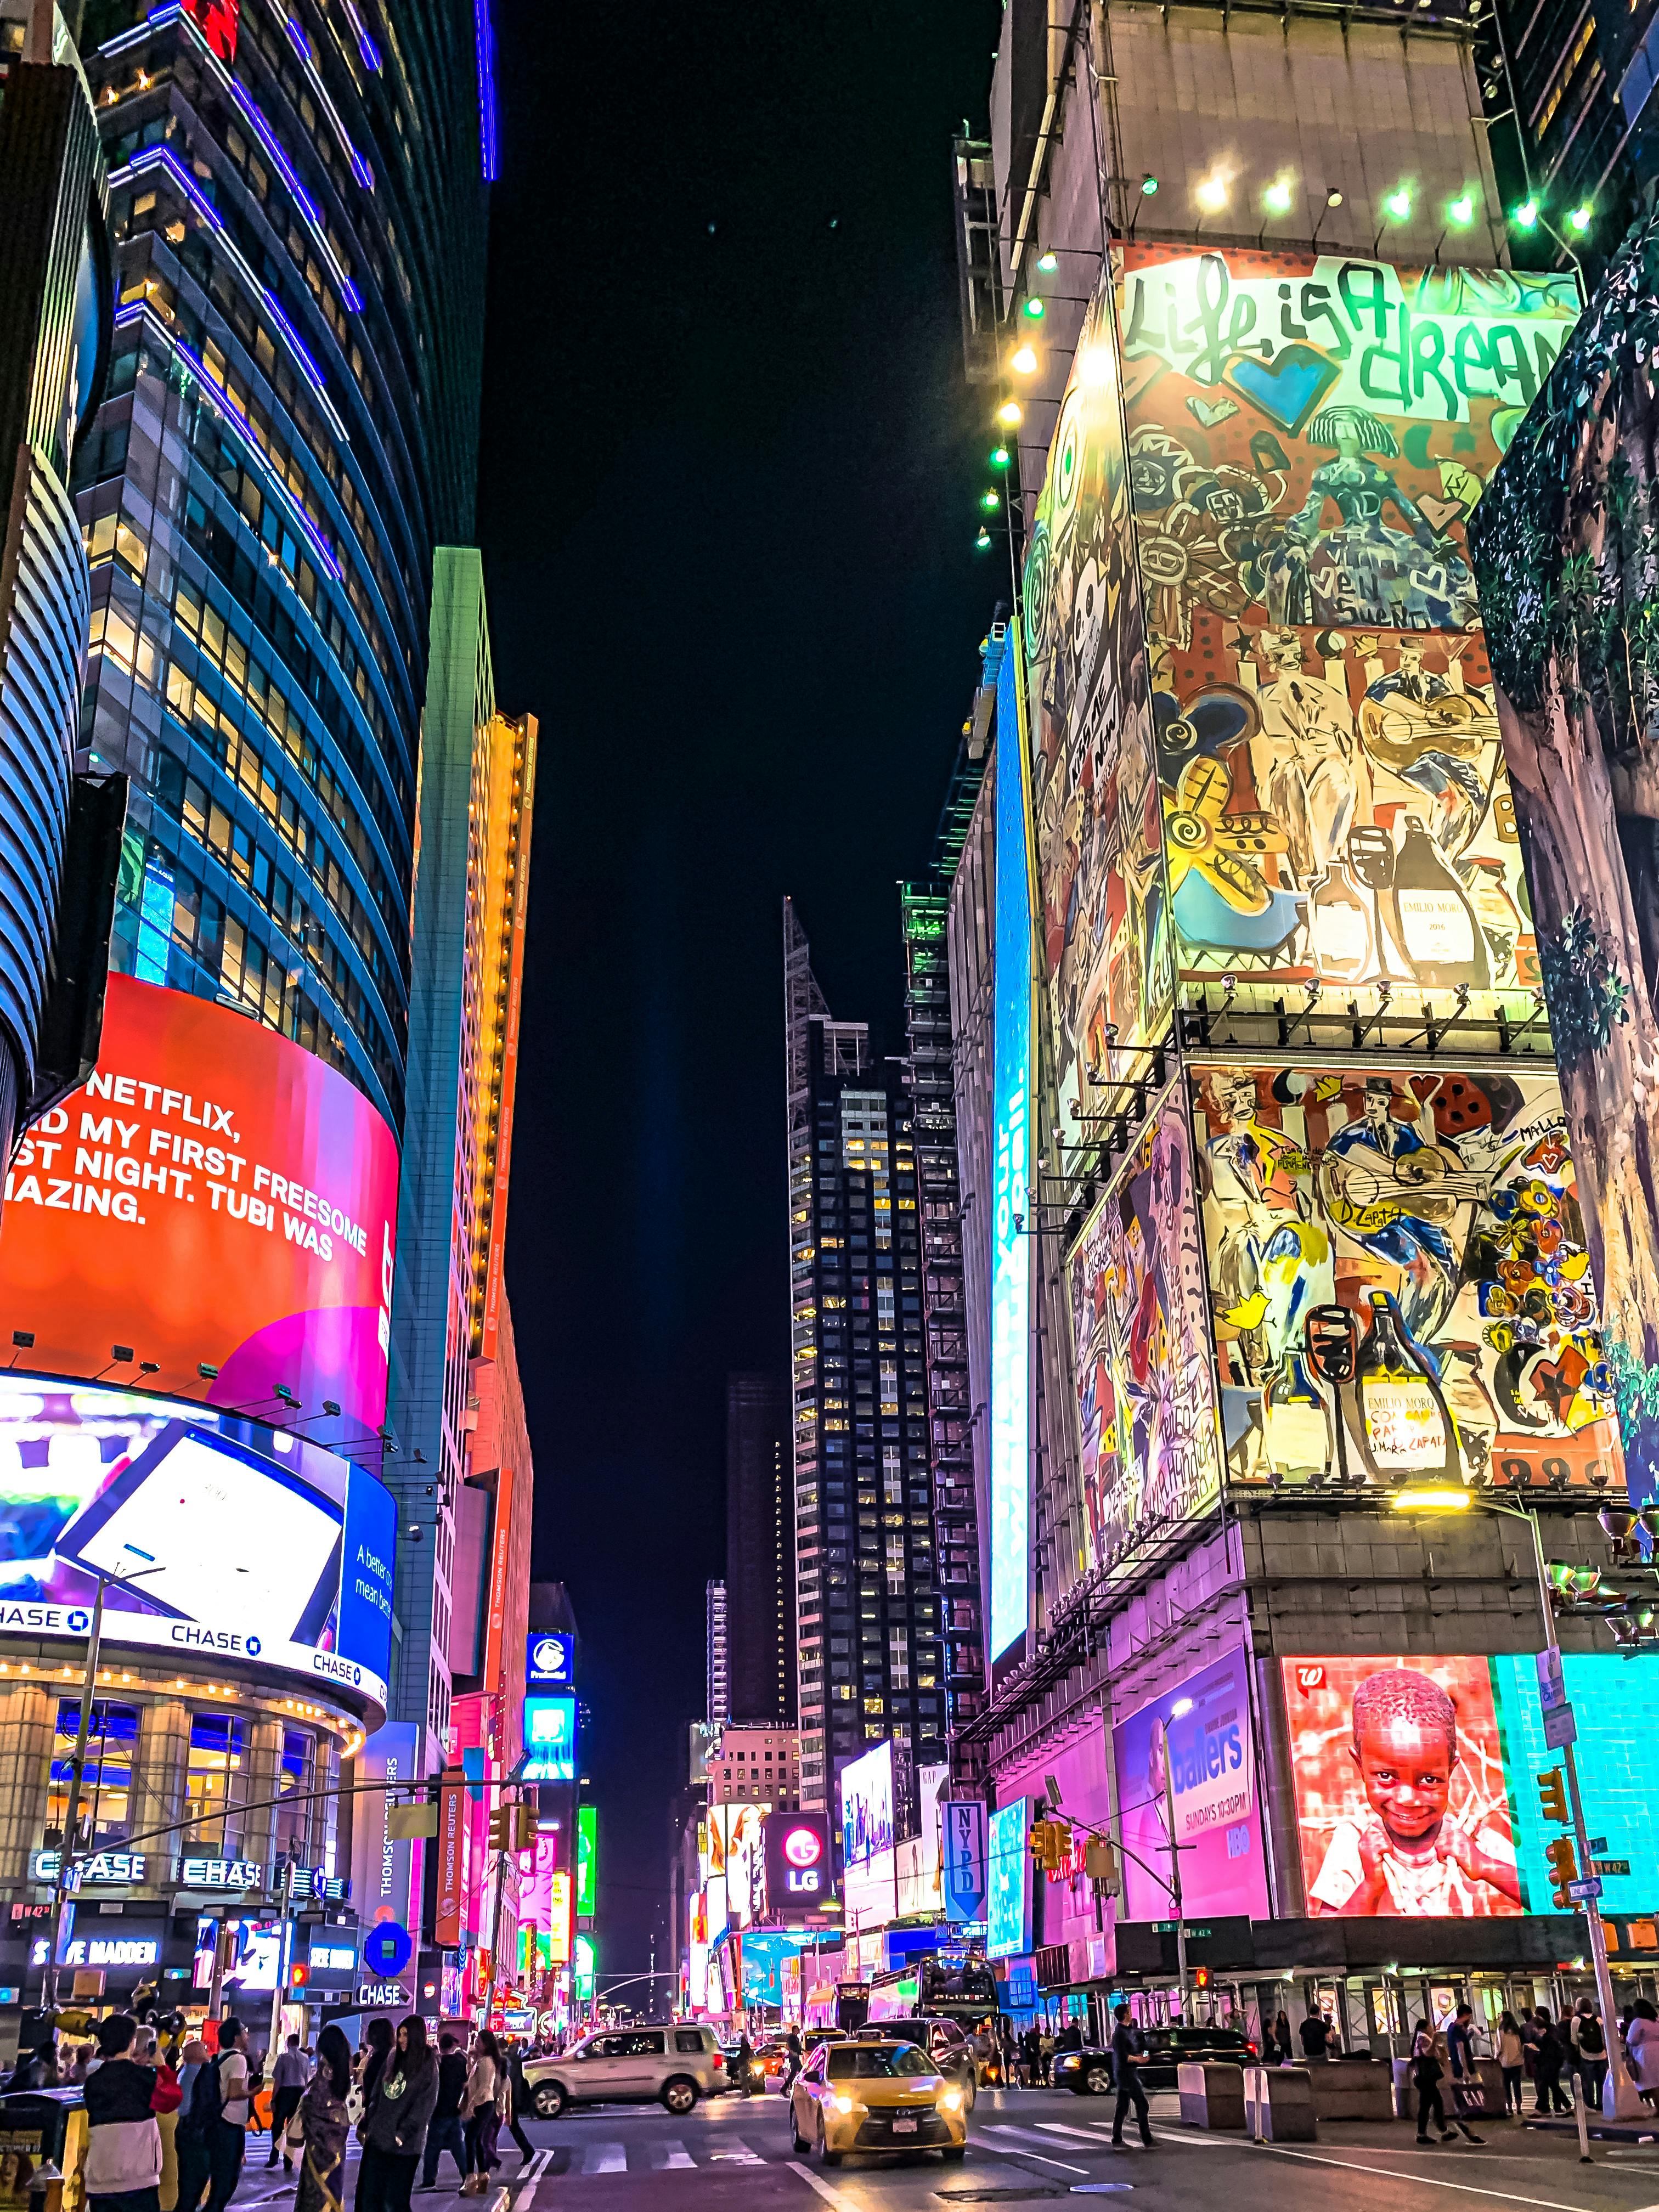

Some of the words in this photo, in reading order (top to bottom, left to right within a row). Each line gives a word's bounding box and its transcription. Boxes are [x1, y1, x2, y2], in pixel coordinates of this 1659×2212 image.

[1337, 261, 1395, 330] A
[1404, 902, 1434, 912] EMILIO
[1437, 903, 1463, 913] MORO
[86, 1071, 240, 1143] NETFLIX,
[79, 1112, 140, 1149] MY
[149, 1128, 246, 1183] FIRST
[255, 1164, 366, 1257] FREESOME
[75, 1146, 194, 1203] NIGHT.
[206, 1180, 274, 1233] TUBI
[283, 1211, 332, 1262] WAS
[1368, 1398, 1401, 1409] EMILIO
[357, 1544, 364, 1564] A
[366, 1547, 386, 1580] better
[356, 1579, 378, 1606] mean
[172, 1625, 241, 1651] CHASE
[314, 1654, 352, 1679] CHASE
[1171, 1724, 1242, 1795] ballers
[923, 1771, 936, 1784] GAP
[448, 1794, 456, 1839] REUTERS
[1186, 1804, 1216, 1831] SUNDAYS
[1217, 1792, 1246, 1819] 10:30PM
[958, 1808, 973, 1892] NYPD
[1227, 1825, 1250, 1859] HBO
[183, 1860, 261, 1886] CHASE
[445, 1841, 455, 1892] THOMSON
[1612, 1863, 1621, 1873] 42
[789, 1870, 819, 1892] LG
[32, 1905, 42, 1917] 42
[89, 1942, 157, 1964] MADDEN
[359, 1984, 400, 2005] CHASE
